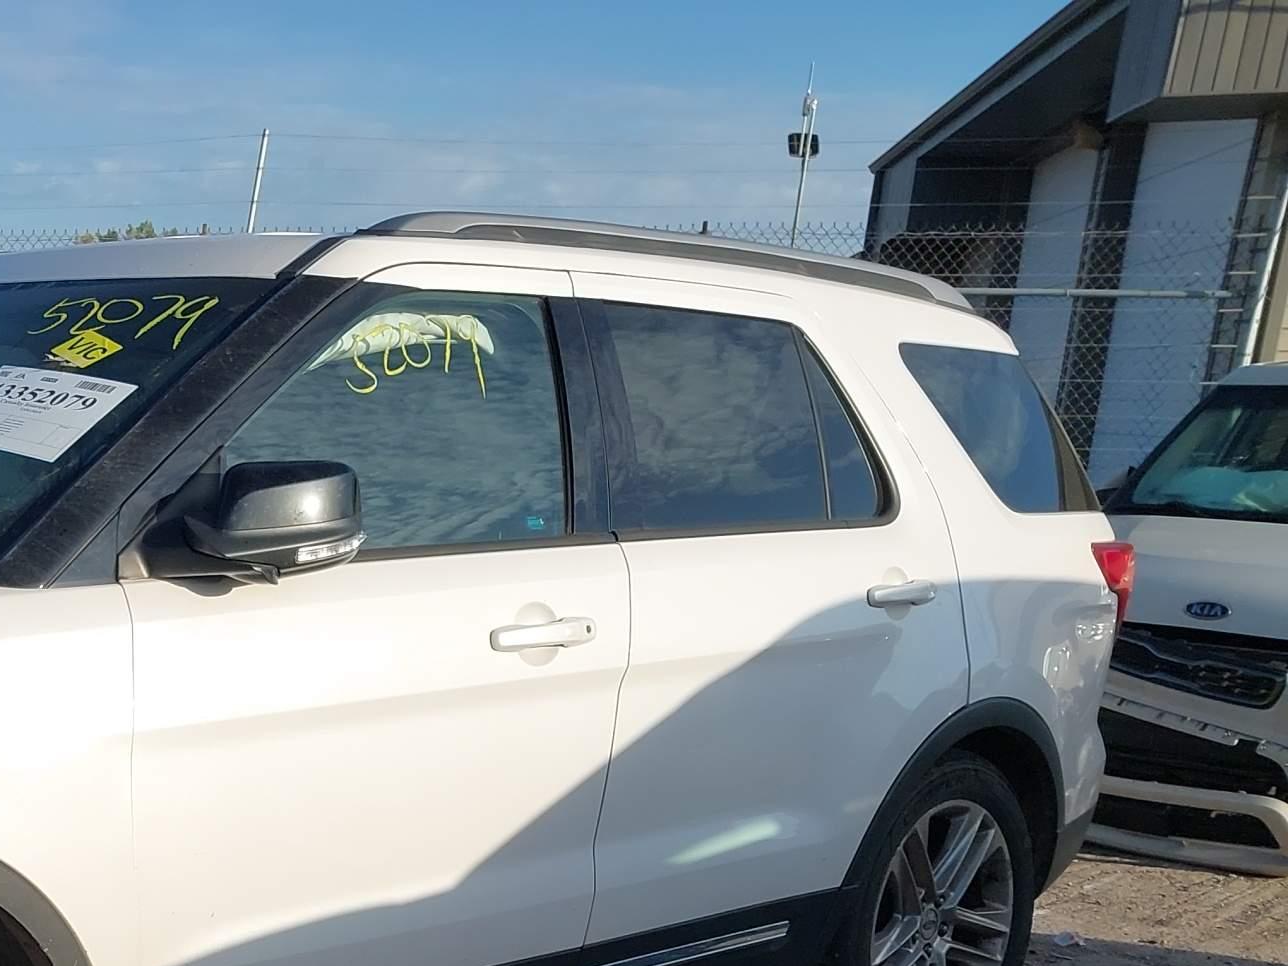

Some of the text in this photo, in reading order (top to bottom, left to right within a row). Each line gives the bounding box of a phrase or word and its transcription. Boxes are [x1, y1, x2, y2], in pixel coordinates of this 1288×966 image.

[27, 295, 219, 350] 52079
[66, 336, 108, 361] VIC
[1191, 603, 1224, 616] KIA
